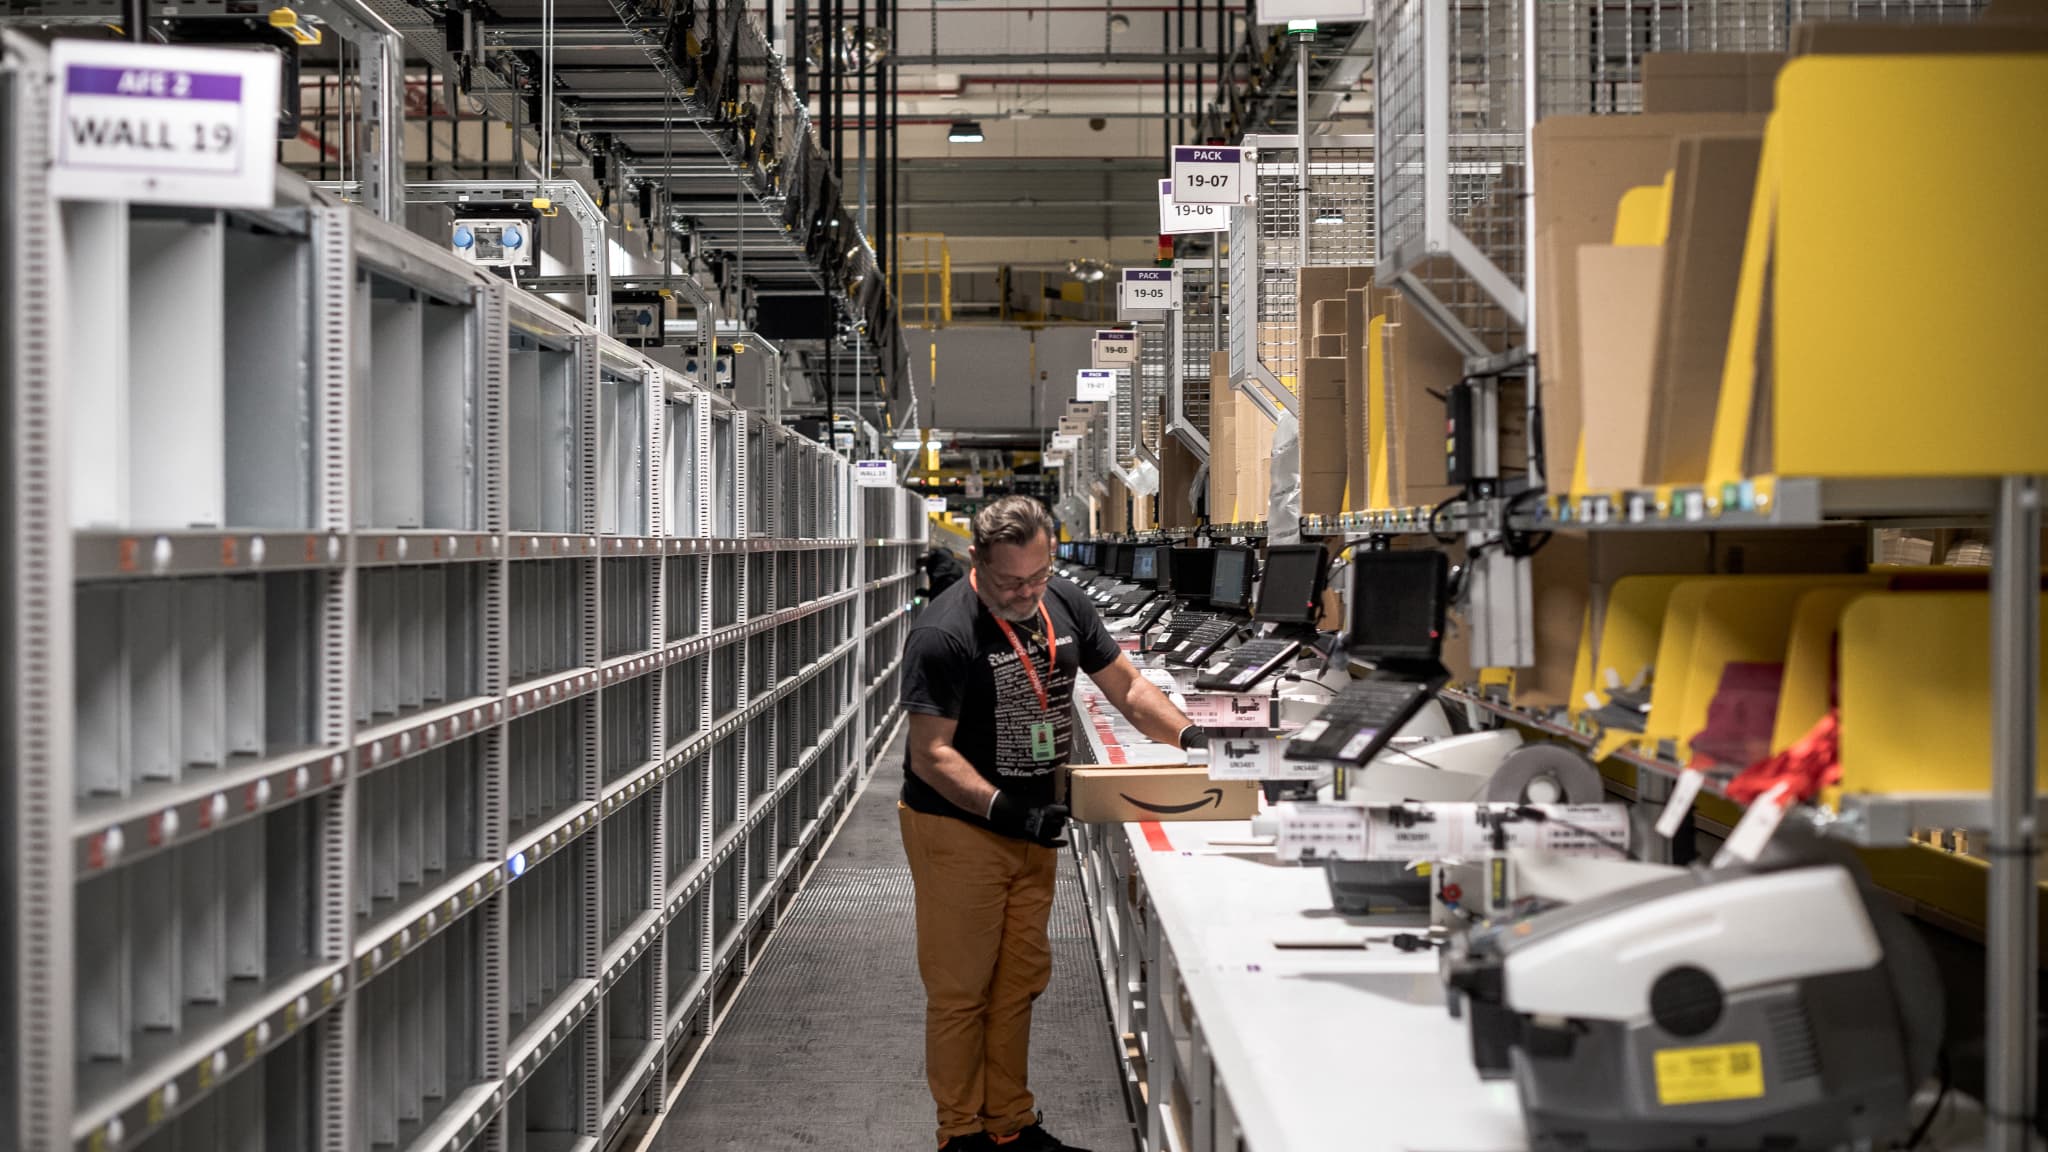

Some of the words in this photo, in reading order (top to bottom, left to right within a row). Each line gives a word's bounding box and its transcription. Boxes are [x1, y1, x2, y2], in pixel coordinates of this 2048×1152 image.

[117, 70, 167, 94] AFE
[172, 73, 191, 97] 2
[69, 116, 175, 150] WALL
[191, 123, 233, 153] 19
[1193, 151, 1222, 161] PACK
[1187, 174, 1229, 187] 19-07
[1175, 205, 1213, 216] 19-06
[1138, 272, 1159, 280] PACK
[1134, 289, 1163, 298] 19-05
[1105, 346, 1128, 354] 19-03
